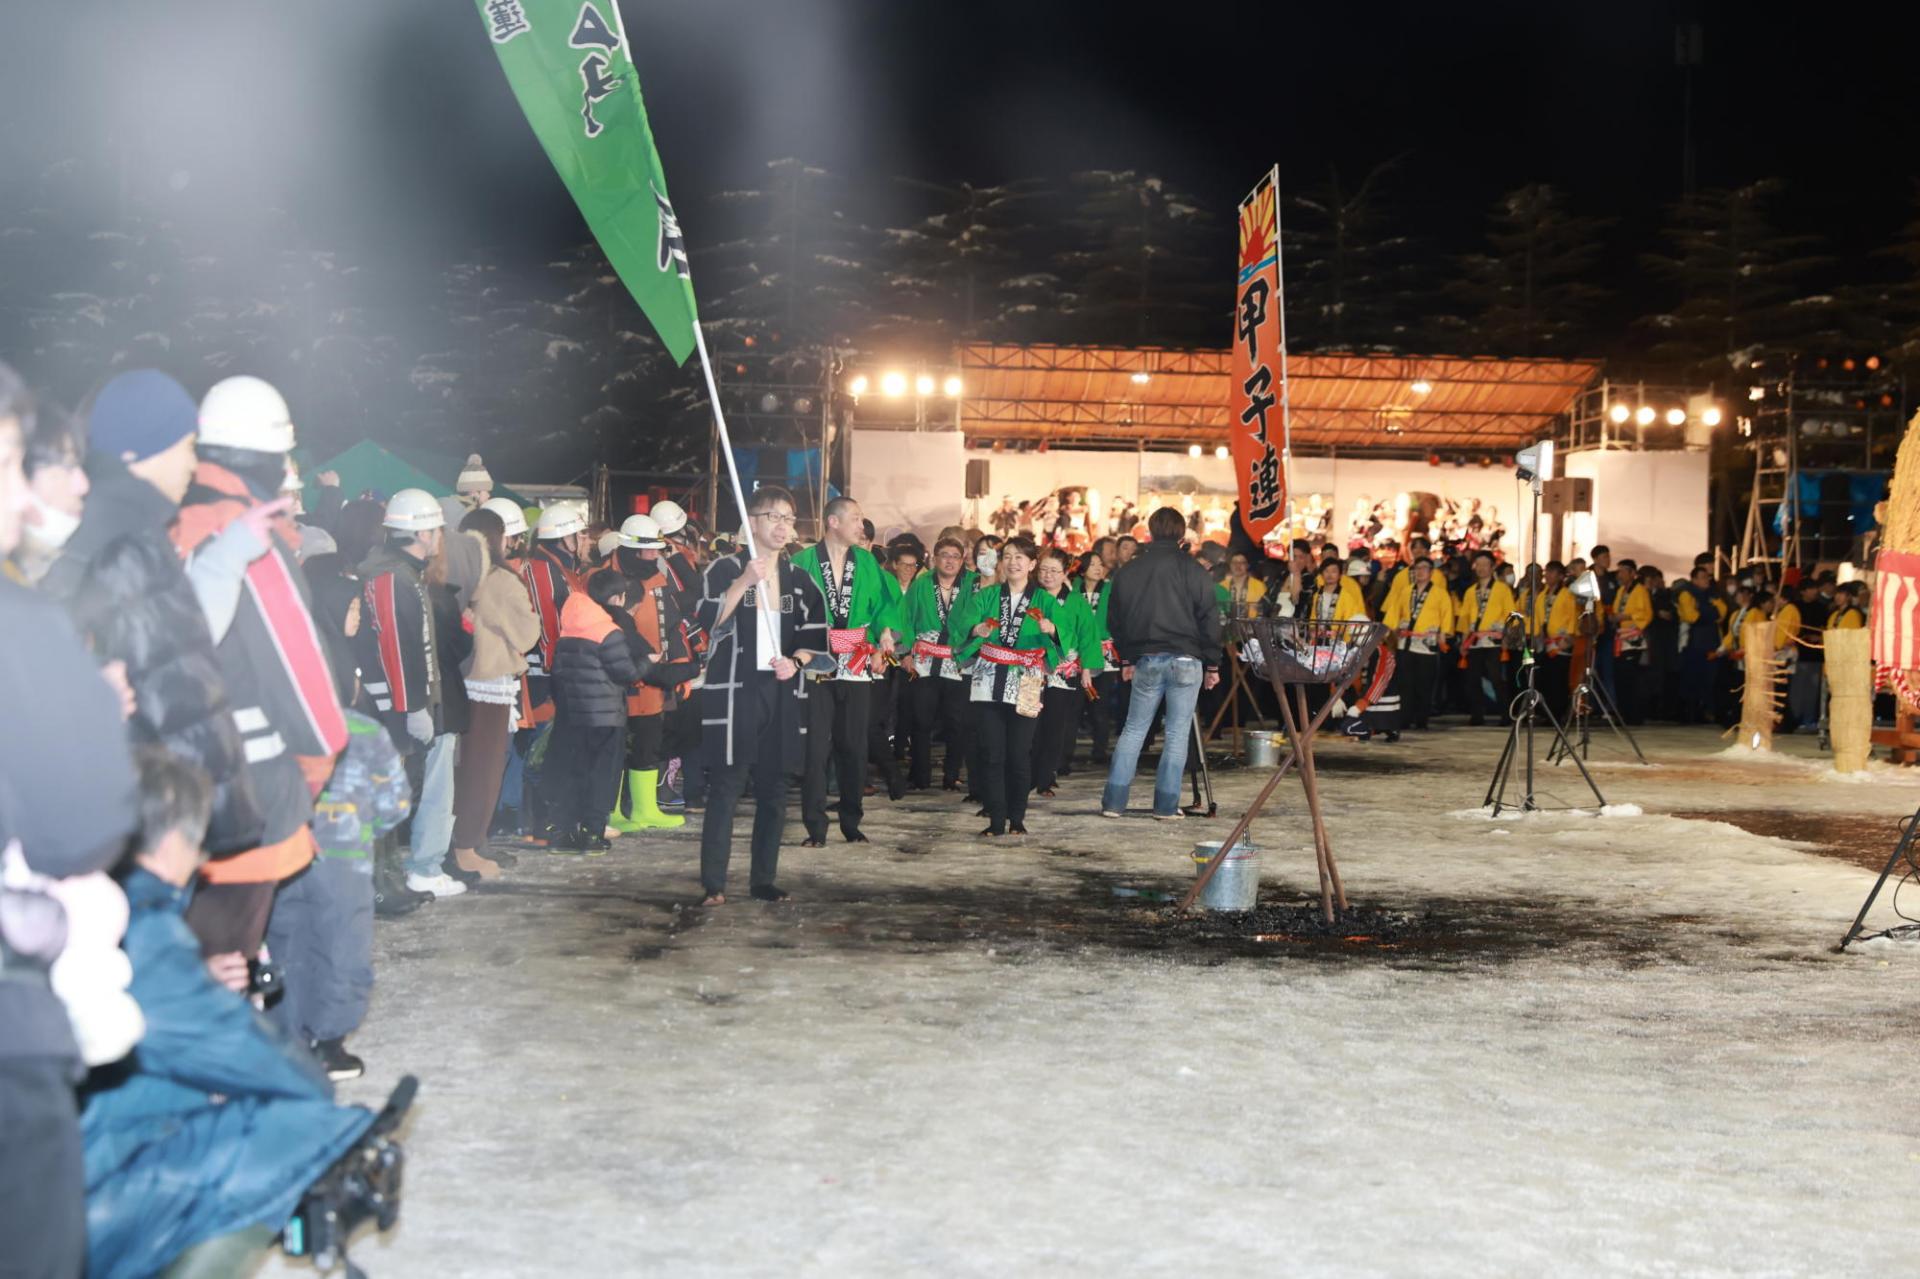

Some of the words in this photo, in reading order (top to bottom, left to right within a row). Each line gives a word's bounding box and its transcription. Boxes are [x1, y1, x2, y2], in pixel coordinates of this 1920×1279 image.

[1238, 277, 1280, 521] 甲子連
[844, 561, 855, 581] 岩手
[840, 585, 853, 618] 胆沢町
